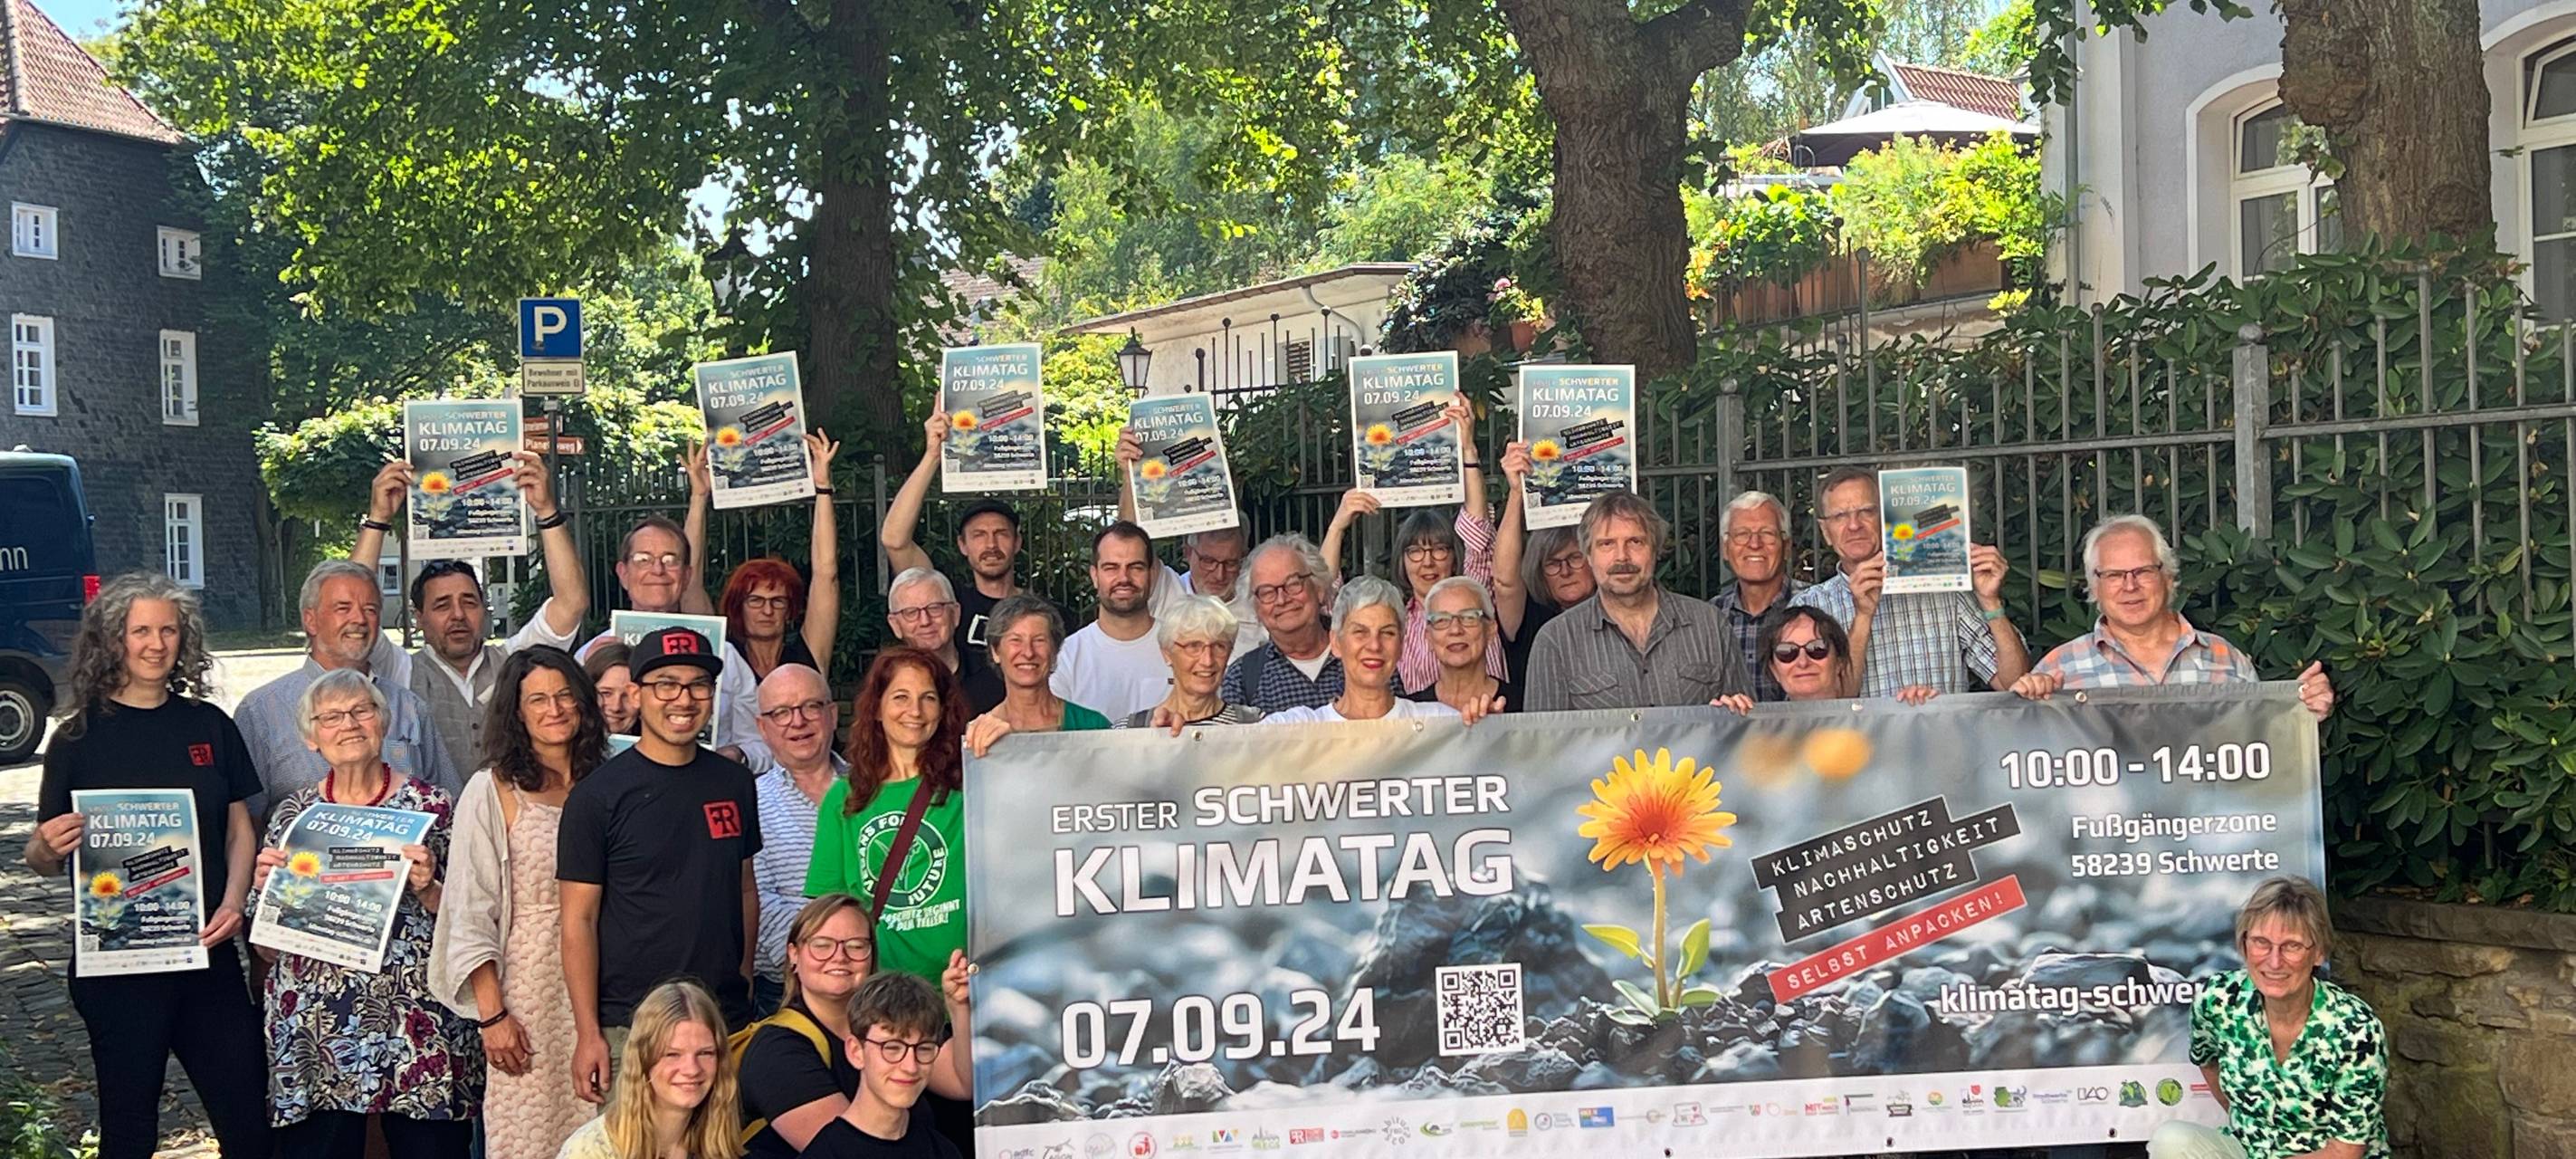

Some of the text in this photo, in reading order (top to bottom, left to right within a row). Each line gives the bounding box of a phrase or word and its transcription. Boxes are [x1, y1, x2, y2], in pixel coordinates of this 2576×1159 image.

[534, 306, 568, 348] P
[953, 363, 1028, 378] KLIMATAG
[708, 373, 787, 394] KLIMATAG
[952, 378, 1005, 392] 07.09.24
[1363, 372, 1445, 389] KLIMATAG
[710, 392, 765, 409] 07.09.24
[1532, 388, 1619, 402] KLIMATAG
[1134, 411, 1204, 429] KLIMATAG
[1532, 405, 1592, 418] 07.09.24
[418, 421, 508, 436] KLIMATAG
[419, 437, 481, 451] 07.09.24
[526, 438, 576, 453] Planeweg
[1890, 483, 1955, 494] KLIMATAG
[1892, 495, 1936, 507] 07.09.24
[2000, 742, 2272, 789] 10:00 - 14:00
[1052, 774, 1511, 833] ERSTER SCHWERTER
[91, 814, 181, 829] KLIMATAG
[306, 819, 374, 842] 07.09.24
[315, 810, 412, 835] KLIMATAG
[878, 814, 906, 829] FO
[2071, 812, 2277, 844] Fußgängerzone
[90, 832, 156, 848] 07.09.24
[1770, 809, 1933, 876] KLIMASCHUTZ
[1793, 817, 1999, 899] NACHHALTIGKEIT
[2071, 848, 2280, 877] 58239 Schwerte
[1054, 829, 1514, 917] KLIMATAG
[1797, 862, 1959, 931] ARTENSCHUTZ
[1786, 892, 2004, 990] SELBST ANPACKEN!
[1061, 986, 1381, 1070] 07.09.24
